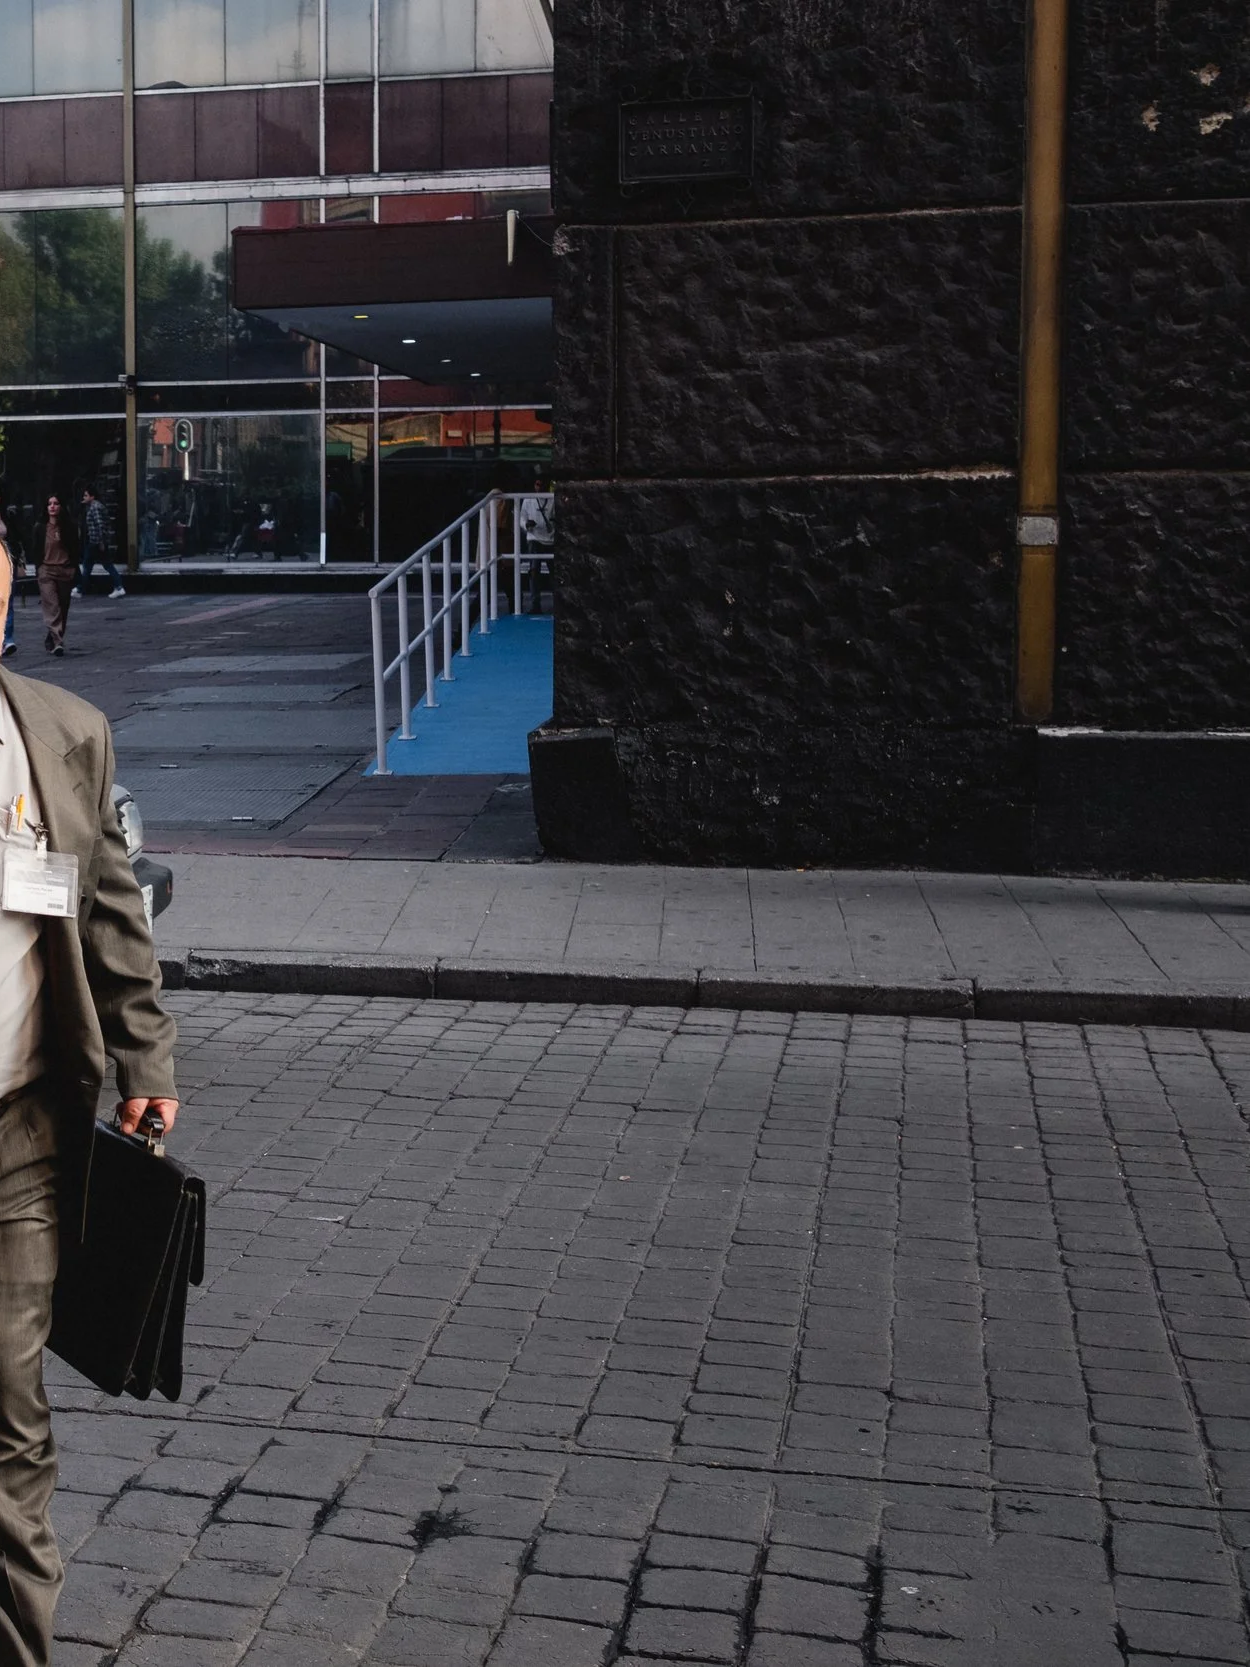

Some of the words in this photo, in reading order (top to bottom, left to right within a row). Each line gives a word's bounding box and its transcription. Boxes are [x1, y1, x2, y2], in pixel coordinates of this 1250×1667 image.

[629, 112, 702, 125] CALLE
[629, 125, 743, 140] VENUSTIANO
[629, 142, 742, 156] CARRANZA
